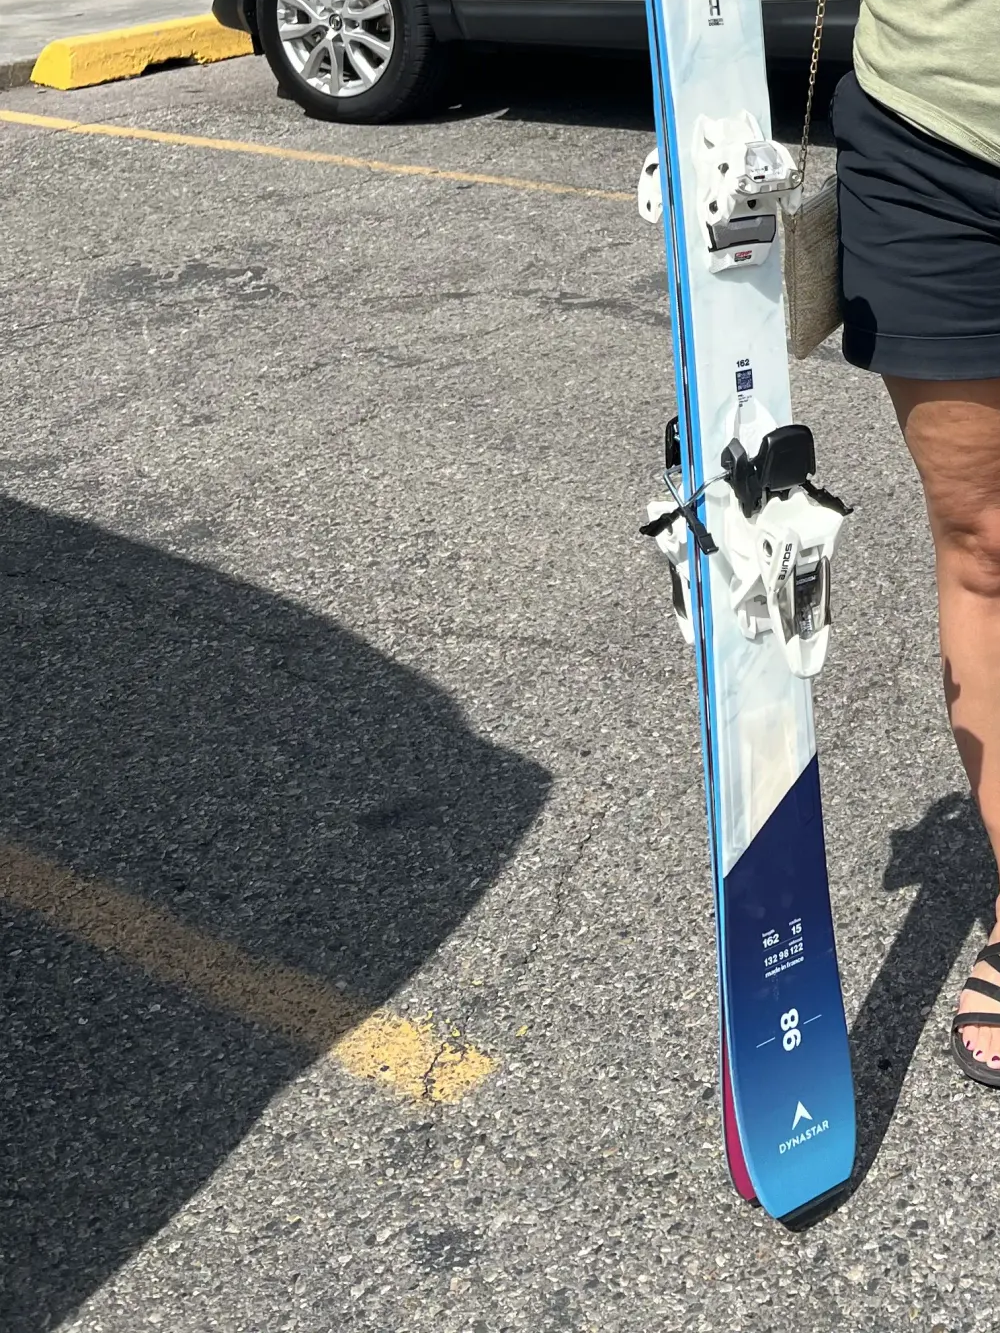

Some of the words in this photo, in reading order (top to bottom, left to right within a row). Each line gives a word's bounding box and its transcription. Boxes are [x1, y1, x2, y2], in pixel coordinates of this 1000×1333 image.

[778, 543, 793, 581] squire
[763, 933, 780, 948] 162
[791, 923, 802, 935] 15
[764, 954, 778, 967] 132
[779, 948, 789, 960] 98
[790, 942, 804, 955] 122
[780, 1008, 802, 1051] 98
[779, 1120, 830, 1154] DYNASTAR
